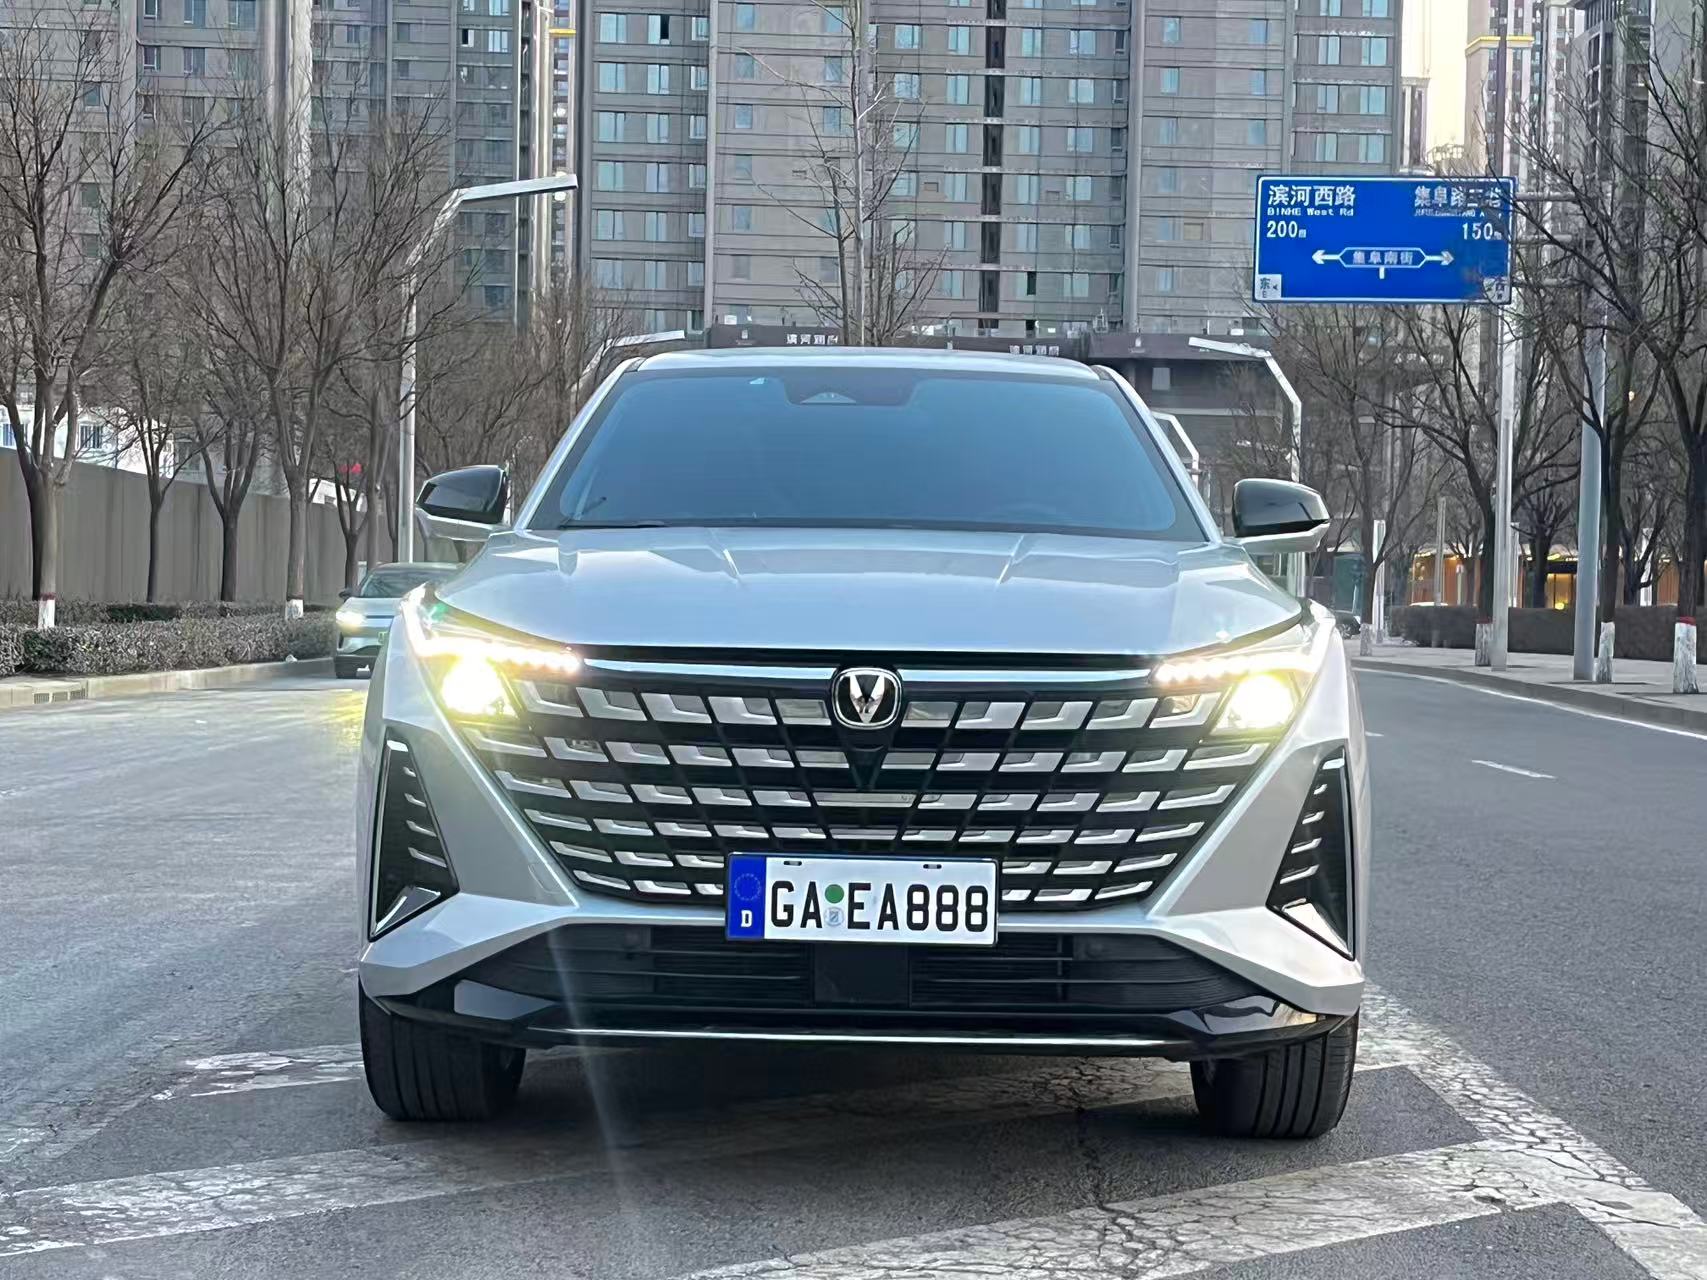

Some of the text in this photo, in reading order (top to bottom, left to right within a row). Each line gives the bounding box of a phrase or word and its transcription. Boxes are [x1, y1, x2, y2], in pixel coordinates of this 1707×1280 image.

[1268, 184, 1356, 206] 滨河西路
[1267, 207, 1354, 216] BINHE West Rd
[771, 880, 989, 932] GA EA888
[740, 910, 753, 928] D
